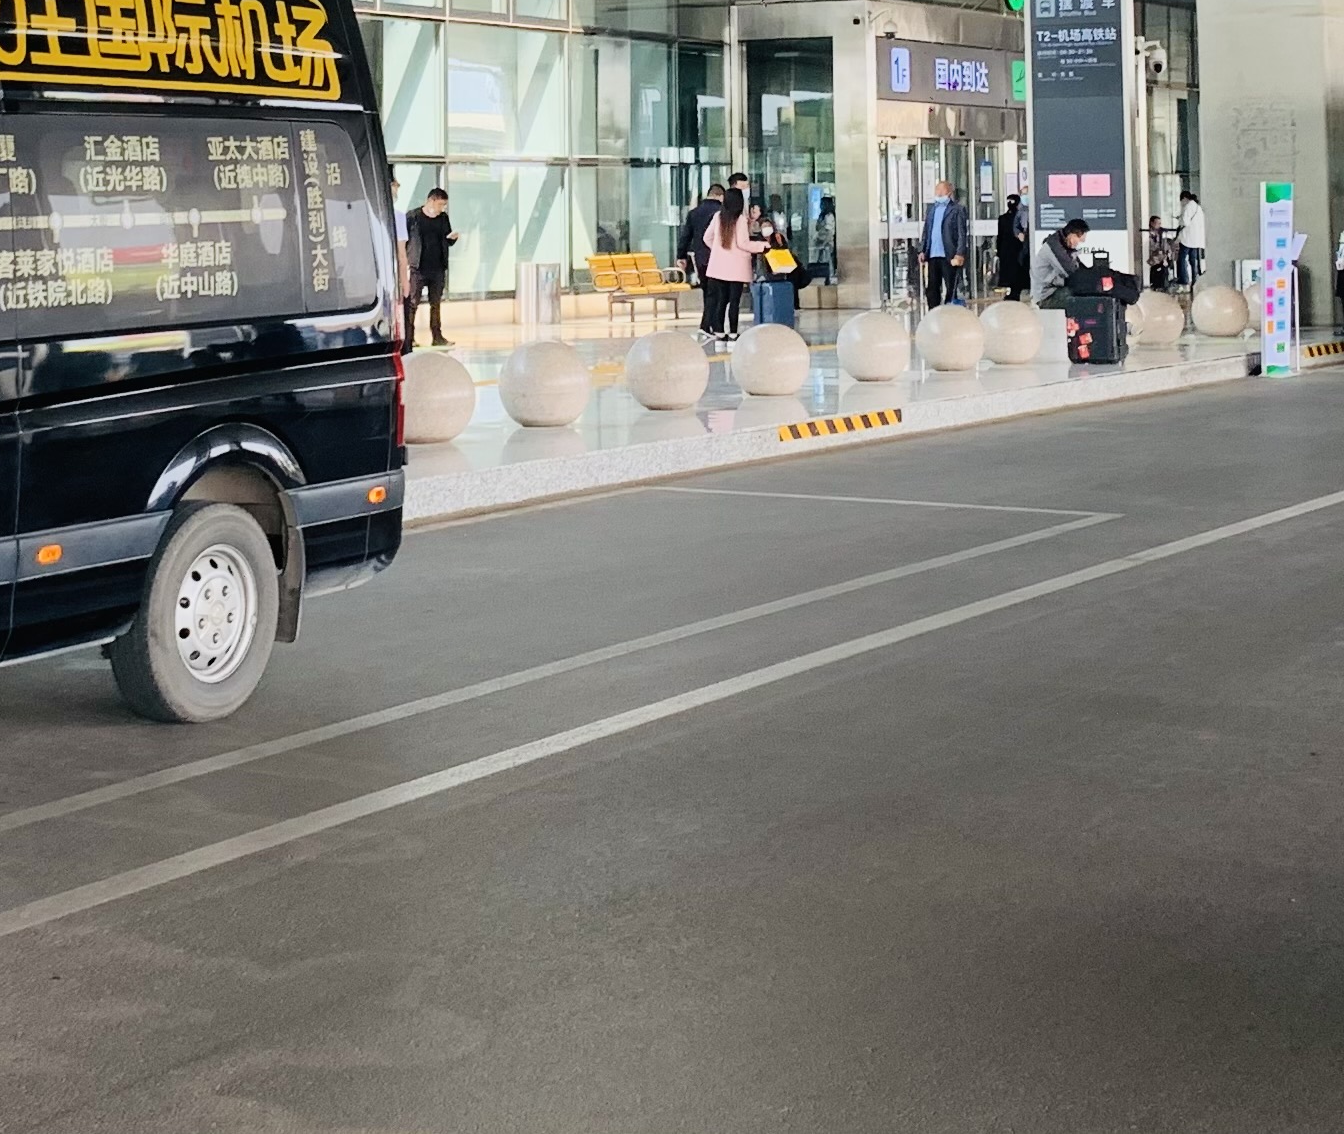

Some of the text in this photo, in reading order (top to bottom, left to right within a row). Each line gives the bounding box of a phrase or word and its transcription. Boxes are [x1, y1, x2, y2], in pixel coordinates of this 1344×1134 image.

[935, 58, 990, 93] 国内到达
[84, 135, 160, 162] 汇金酒店
[207, 136, 290, 161] 亚太大酒店
[161, 240, 232, 269] 华庭酒店
